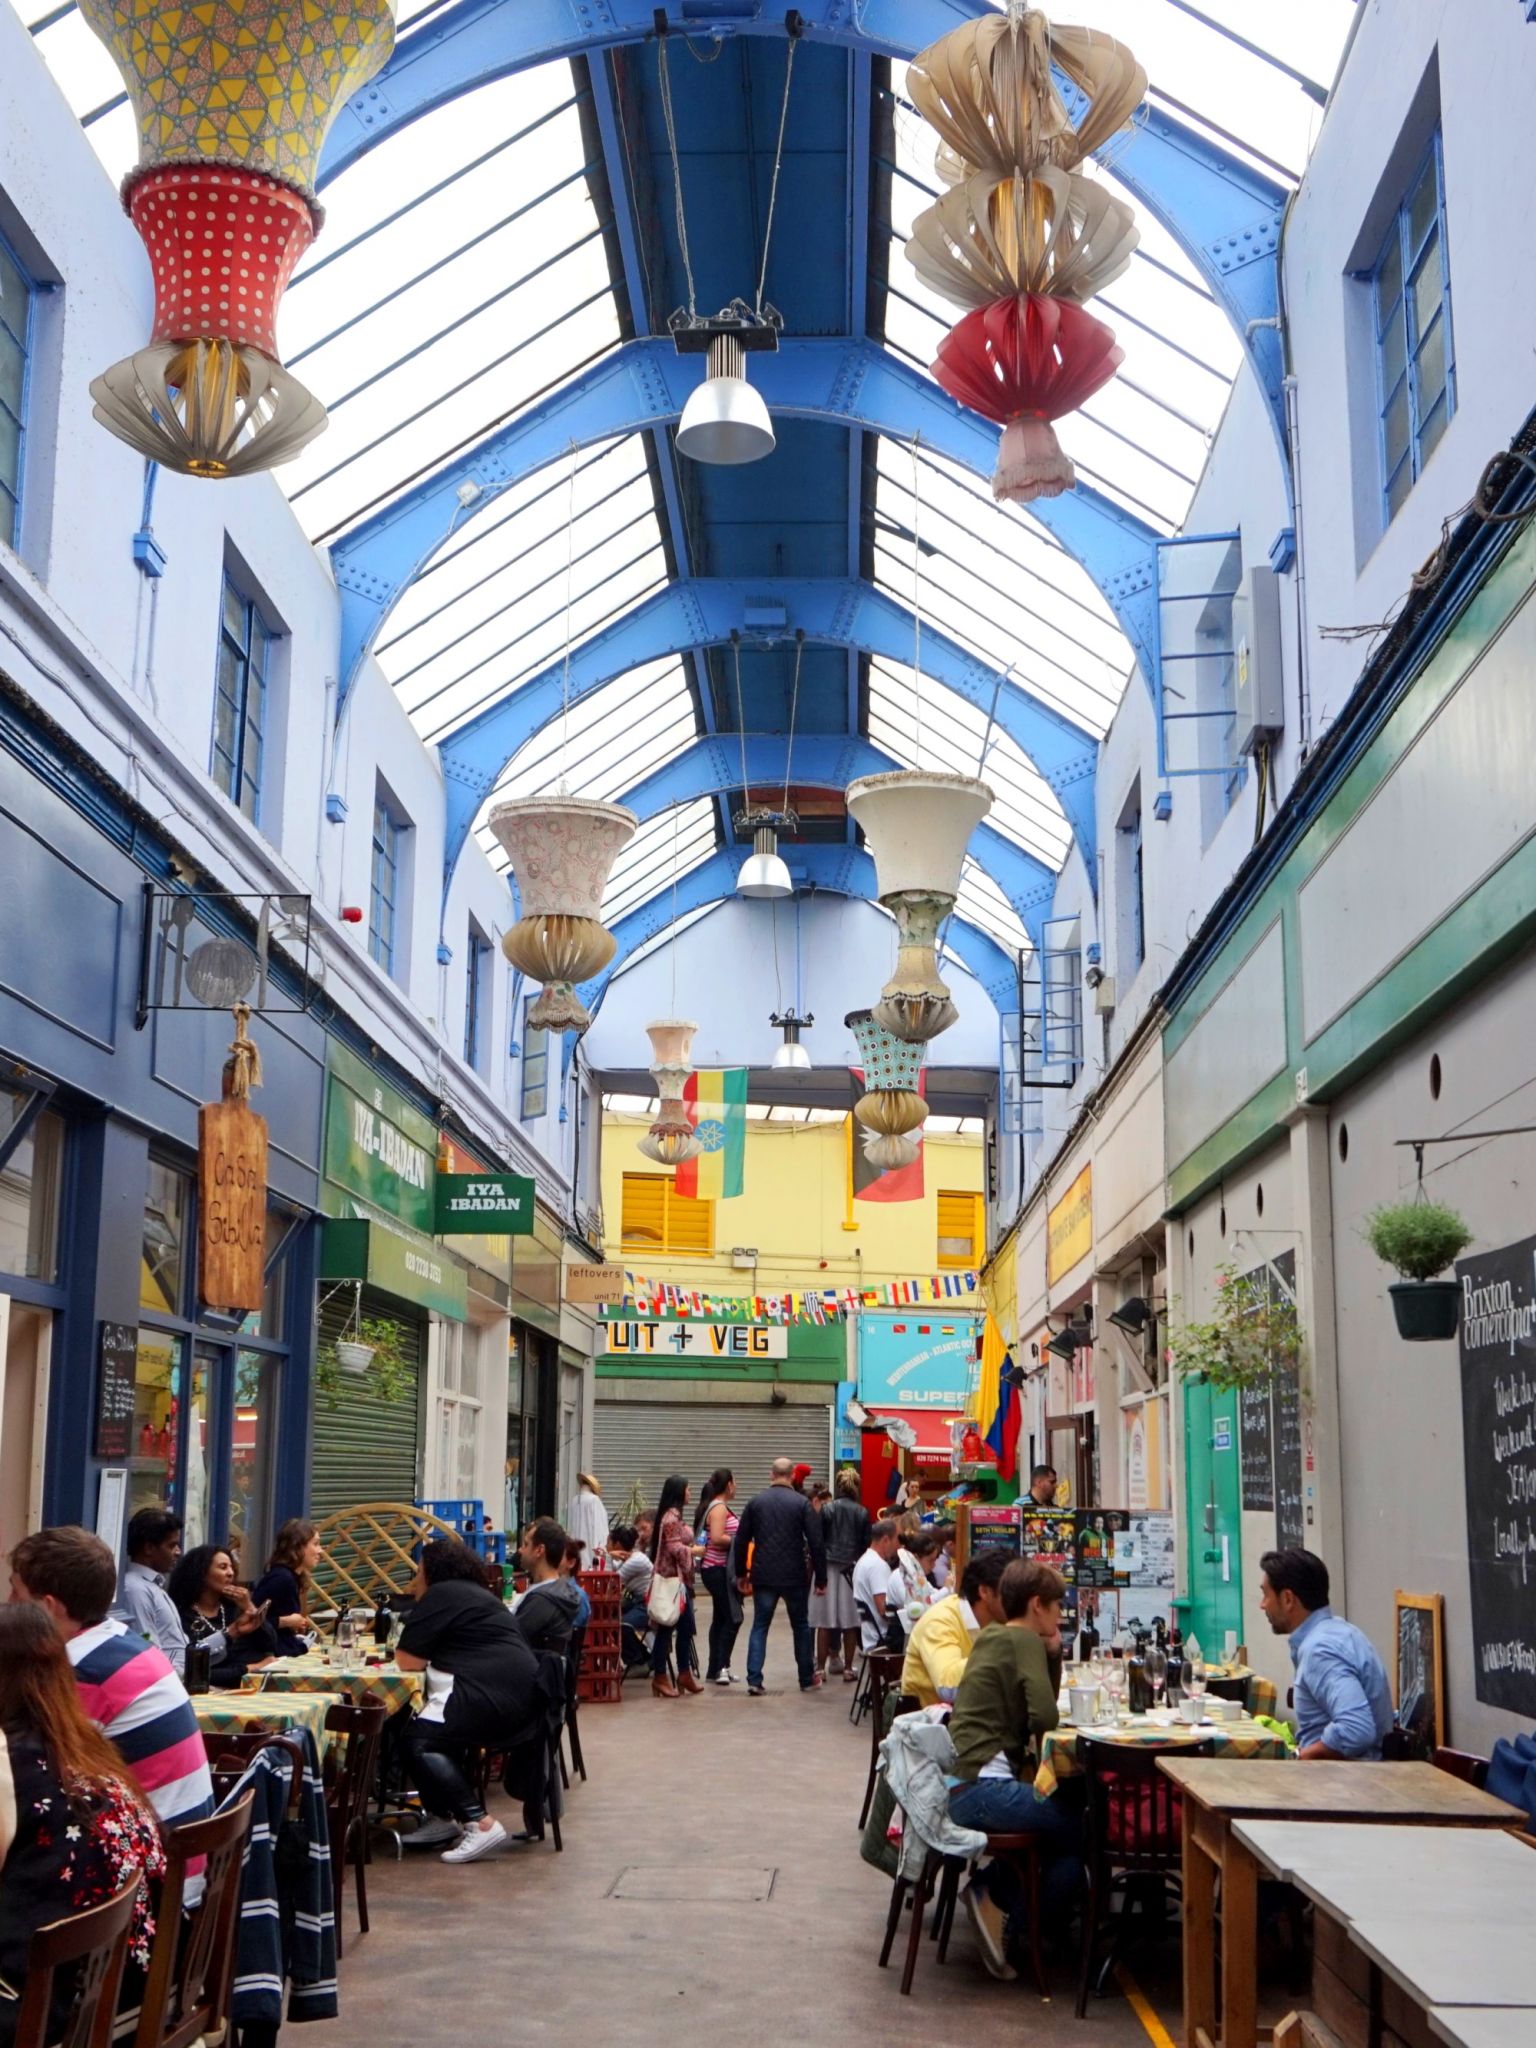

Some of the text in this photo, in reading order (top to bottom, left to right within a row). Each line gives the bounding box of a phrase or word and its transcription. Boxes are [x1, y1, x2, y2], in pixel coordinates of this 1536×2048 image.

[354, 1101, 425, 1190] IYA-IBADAN
[467, 1184, 504, 1196] IYA
[450, 1198, 520, 1211] IBADAN
[569, 1268, 621, 1279] leftovers
[594, 1293, 610, 1301] unit
[1462, 1274, 1513, 1320] Brixton
[709, 1325, 769, 1356] VEG
